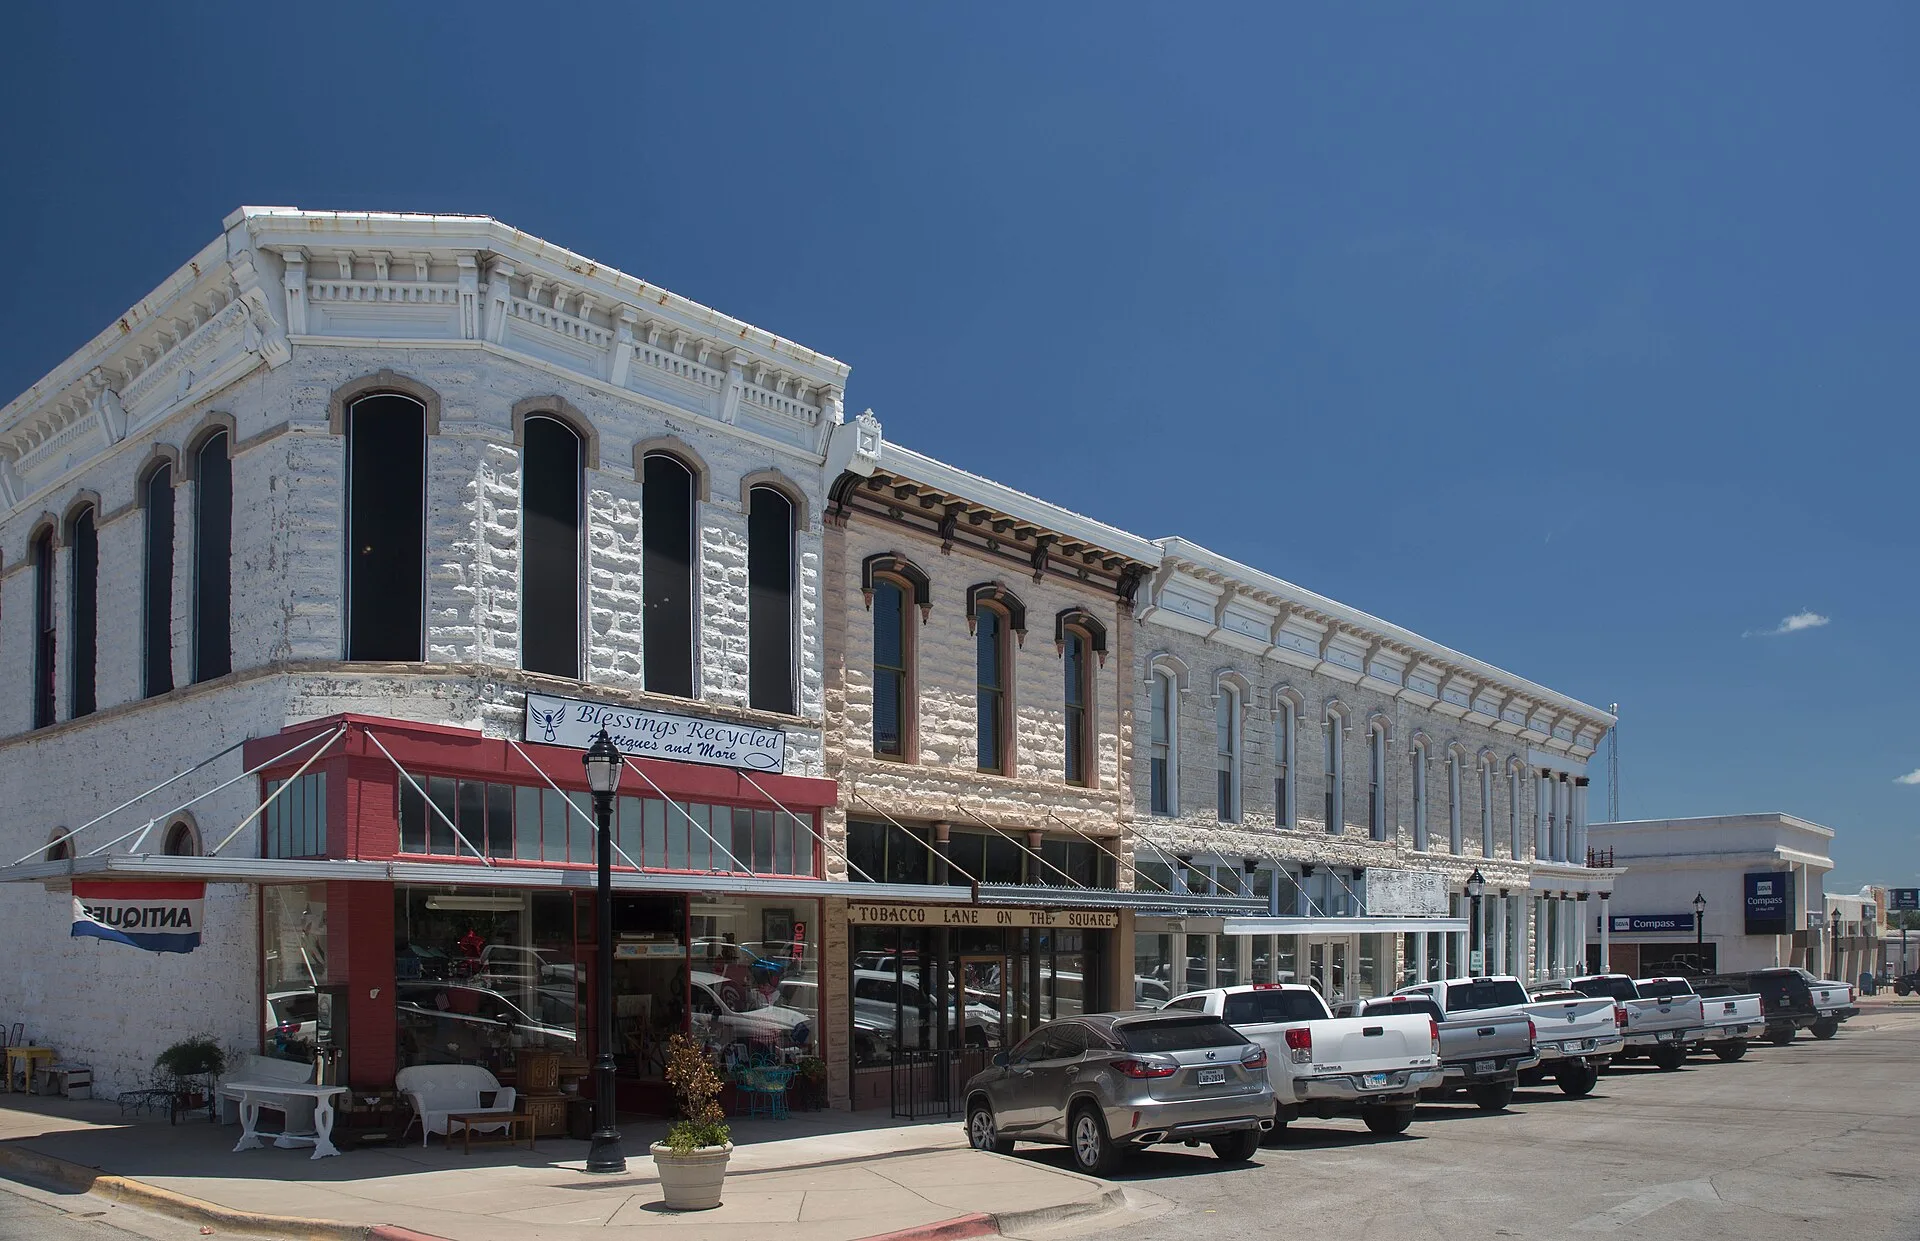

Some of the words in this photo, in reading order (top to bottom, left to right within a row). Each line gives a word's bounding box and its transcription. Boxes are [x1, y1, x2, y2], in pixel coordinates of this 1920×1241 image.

[576, 705, 680, 739] Blessings
[687, 721, 784, 749] Recycled
[588, 729, 658, 751] Atiques
[664, 741, 692, 755] and
[697, 743, 737, 761] More
[1747, 897, 1783, 906] Compass
[859, 906, 925, 922] TOBACCO
[944, 909, 978, 924] LANE
[997, 910, 1012, 925] ON
[1029, 911, 1052, 925] THE
[1068, 912, 1112, 927] SQUARE
[1633, 919, 1675, 929] Compass
